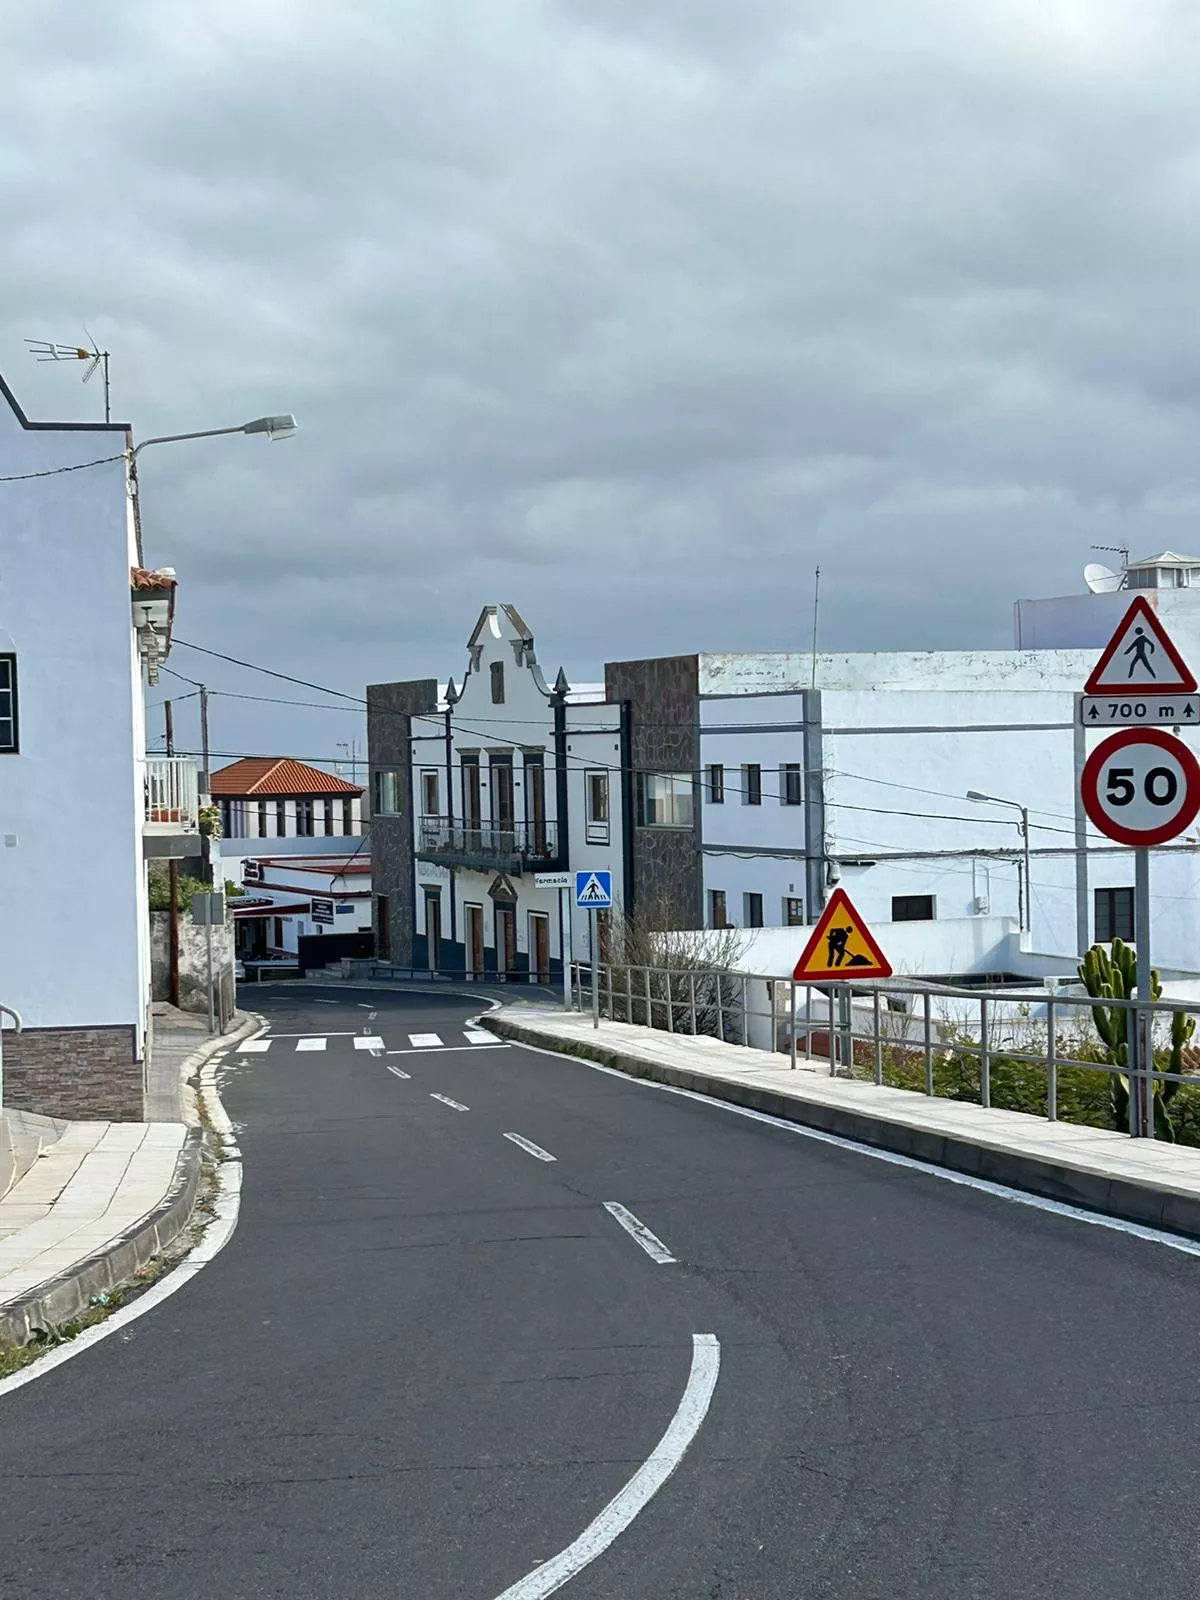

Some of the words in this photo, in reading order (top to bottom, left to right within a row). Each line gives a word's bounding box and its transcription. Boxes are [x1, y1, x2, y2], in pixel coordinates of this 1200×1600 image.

[1108, 703, 1147, 718] 700
[1159, 706, 1175, 718] m
[1106, 767, 1178, 807] 50
